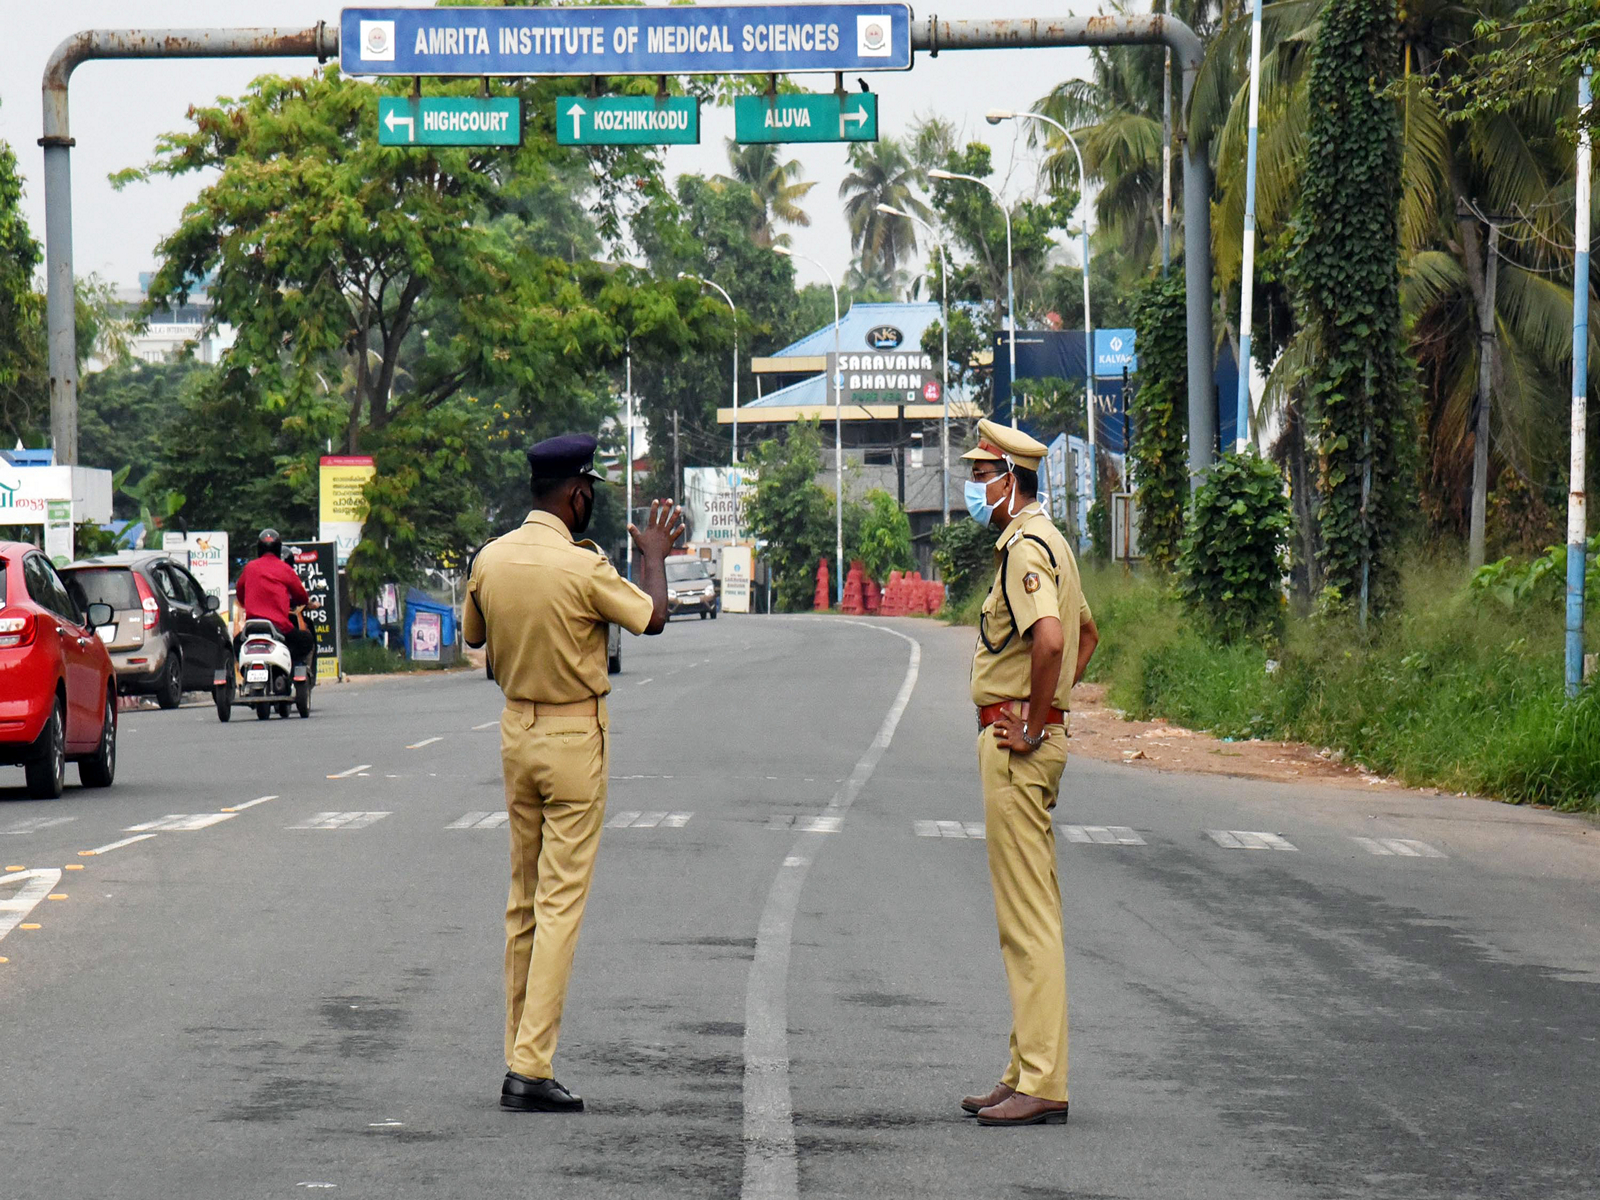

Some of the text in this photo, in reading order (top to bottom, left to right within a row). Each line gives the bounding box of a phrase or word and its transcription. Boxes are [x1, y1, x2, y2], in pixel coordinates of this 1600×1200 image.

[414, 24, 839, 55] AMRITA INSTITUTE OF MEDICAL SCIENCES
[423, 111, 509, 131] HIGHCOURT
[594, 111, 688, 130] KOZHIKKODU
[764, 109, 811, 128] ALUVA
[839, 355, 932, 371] SARAVANA
[850, 374, 921, 390] BHAVAN
[704, 501, 749, 512] SARAVA
[711, 514, 749, 526] BHAVA
[308, 594, 326, 606] OT
